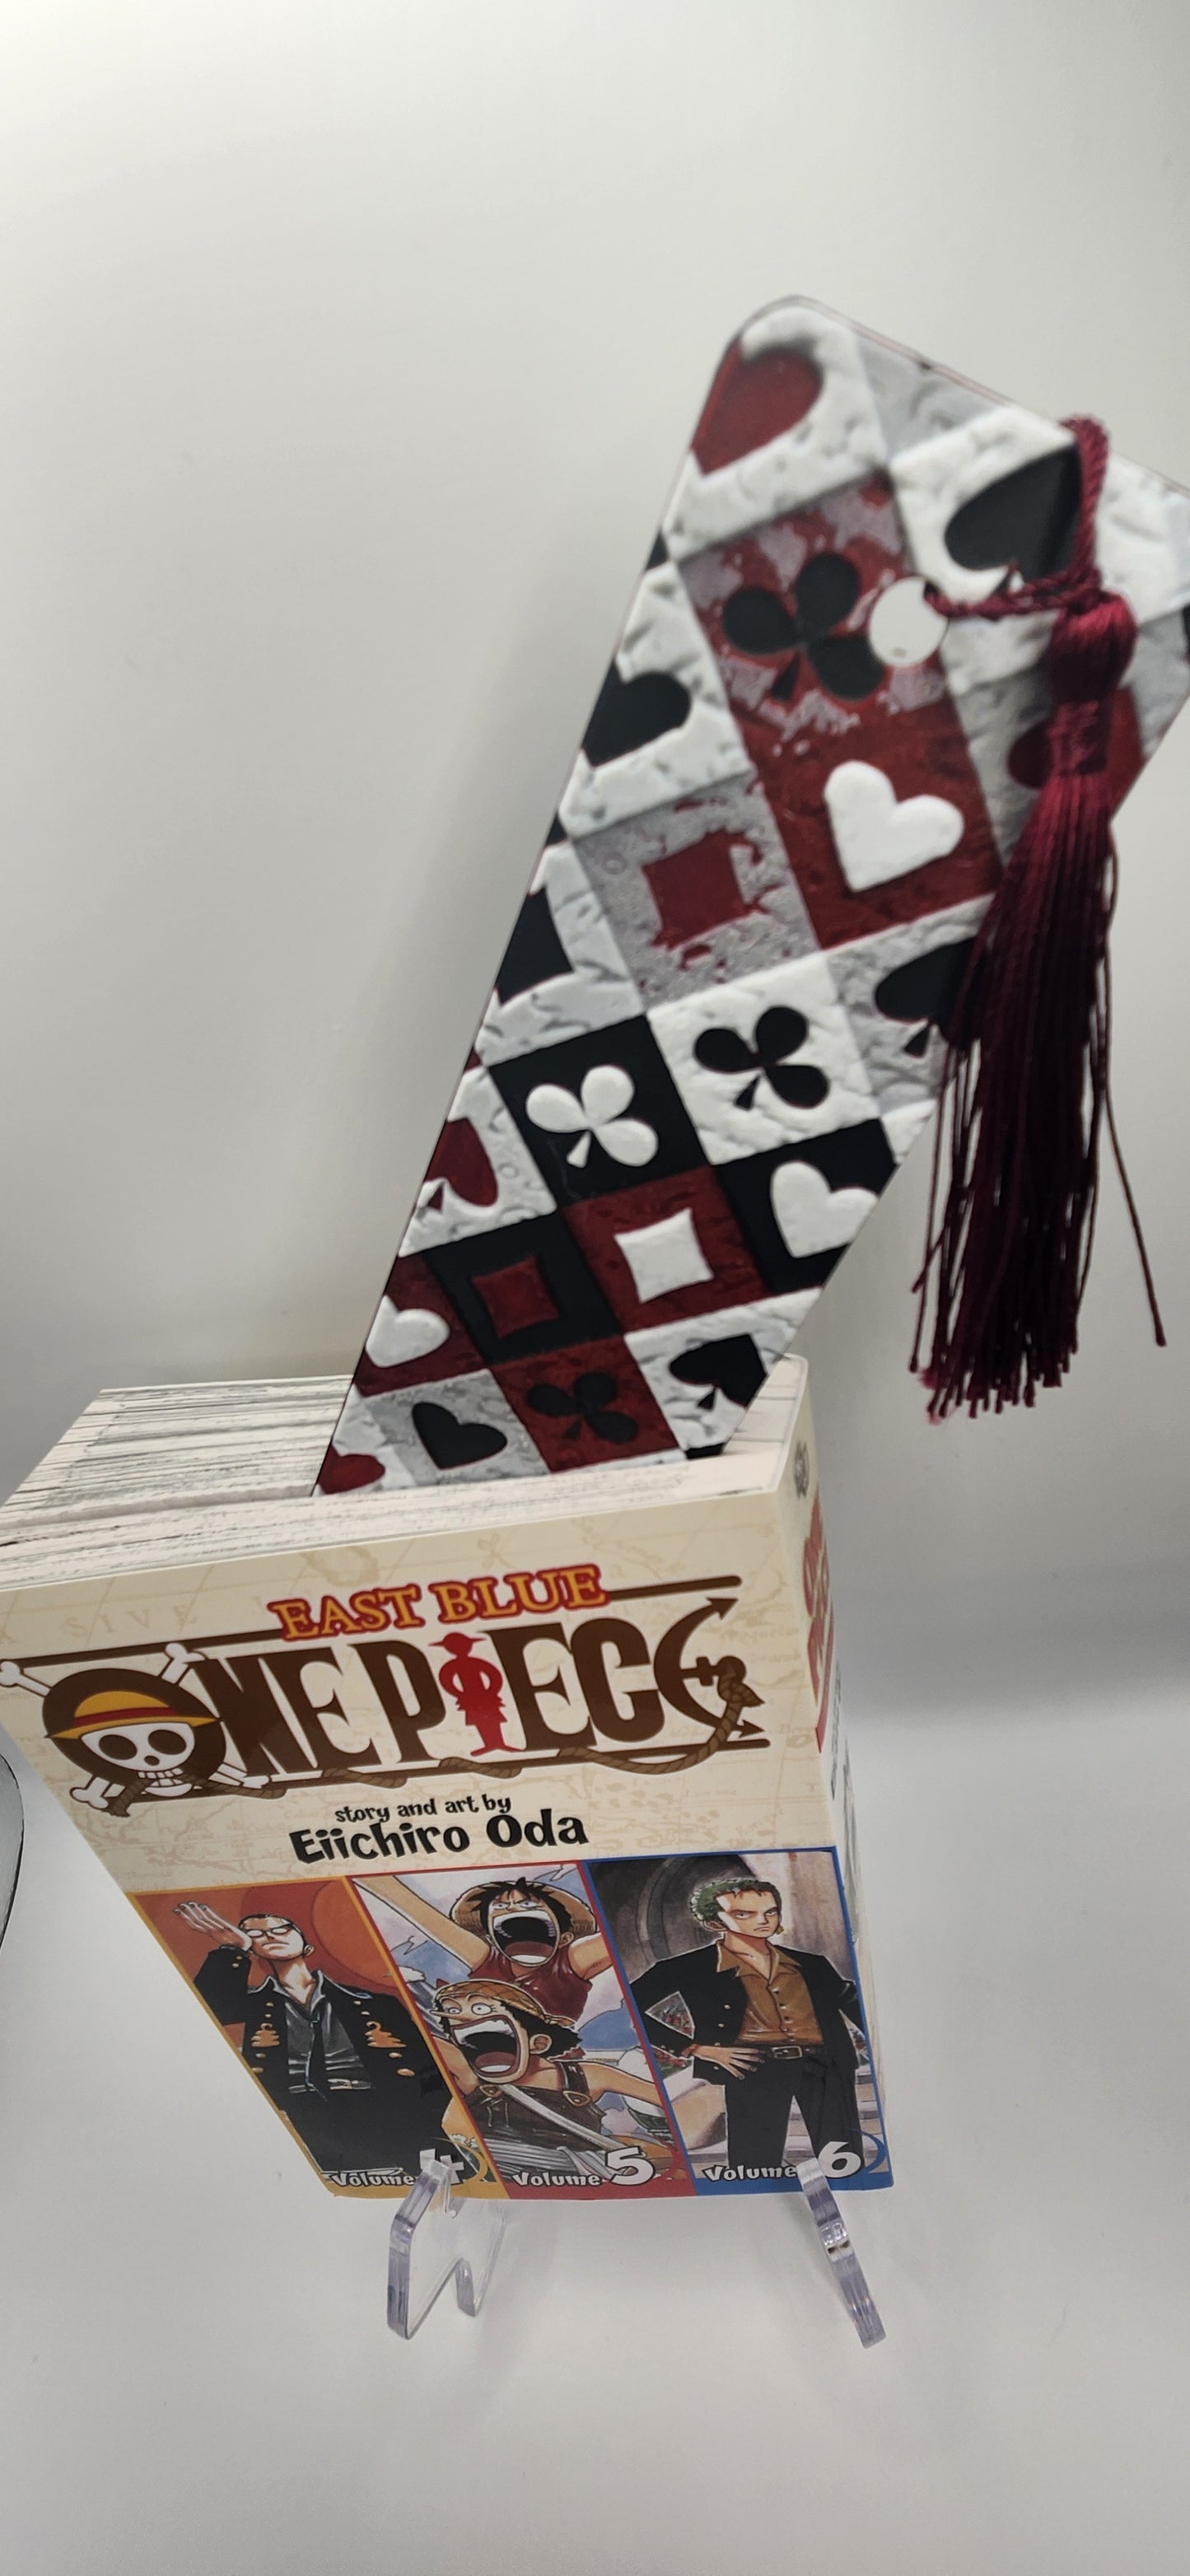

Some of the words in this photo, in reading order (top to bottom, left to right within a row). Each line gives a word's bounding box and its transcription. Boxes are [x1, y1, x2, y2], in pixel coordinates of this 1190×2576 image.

[267, 1584, 425, 1641] EAST
[428, 1563, 610, 1623] BLUE
[41, 1638, 380, 1790] ONE
[347, 1596, 766, 1764] PIECE
[334, 1805, 390, 1823] story
[397, 1799, 437, 1817] and
[445, 1795, 479, 1813] art
[481, 1794, 511, 1813] by
[289, 1822, 470, 1864] Eiichiro
[486, 1808, 589, 1848] Oda
[329, 2172, 415, 2187] Volume
[511, 2171, 603, 2187] Volume
[604, 2145, 656, 2186] 5
[701, 2164, 797, 2182] Volume
[816, 2140, 864, 2180] 6
